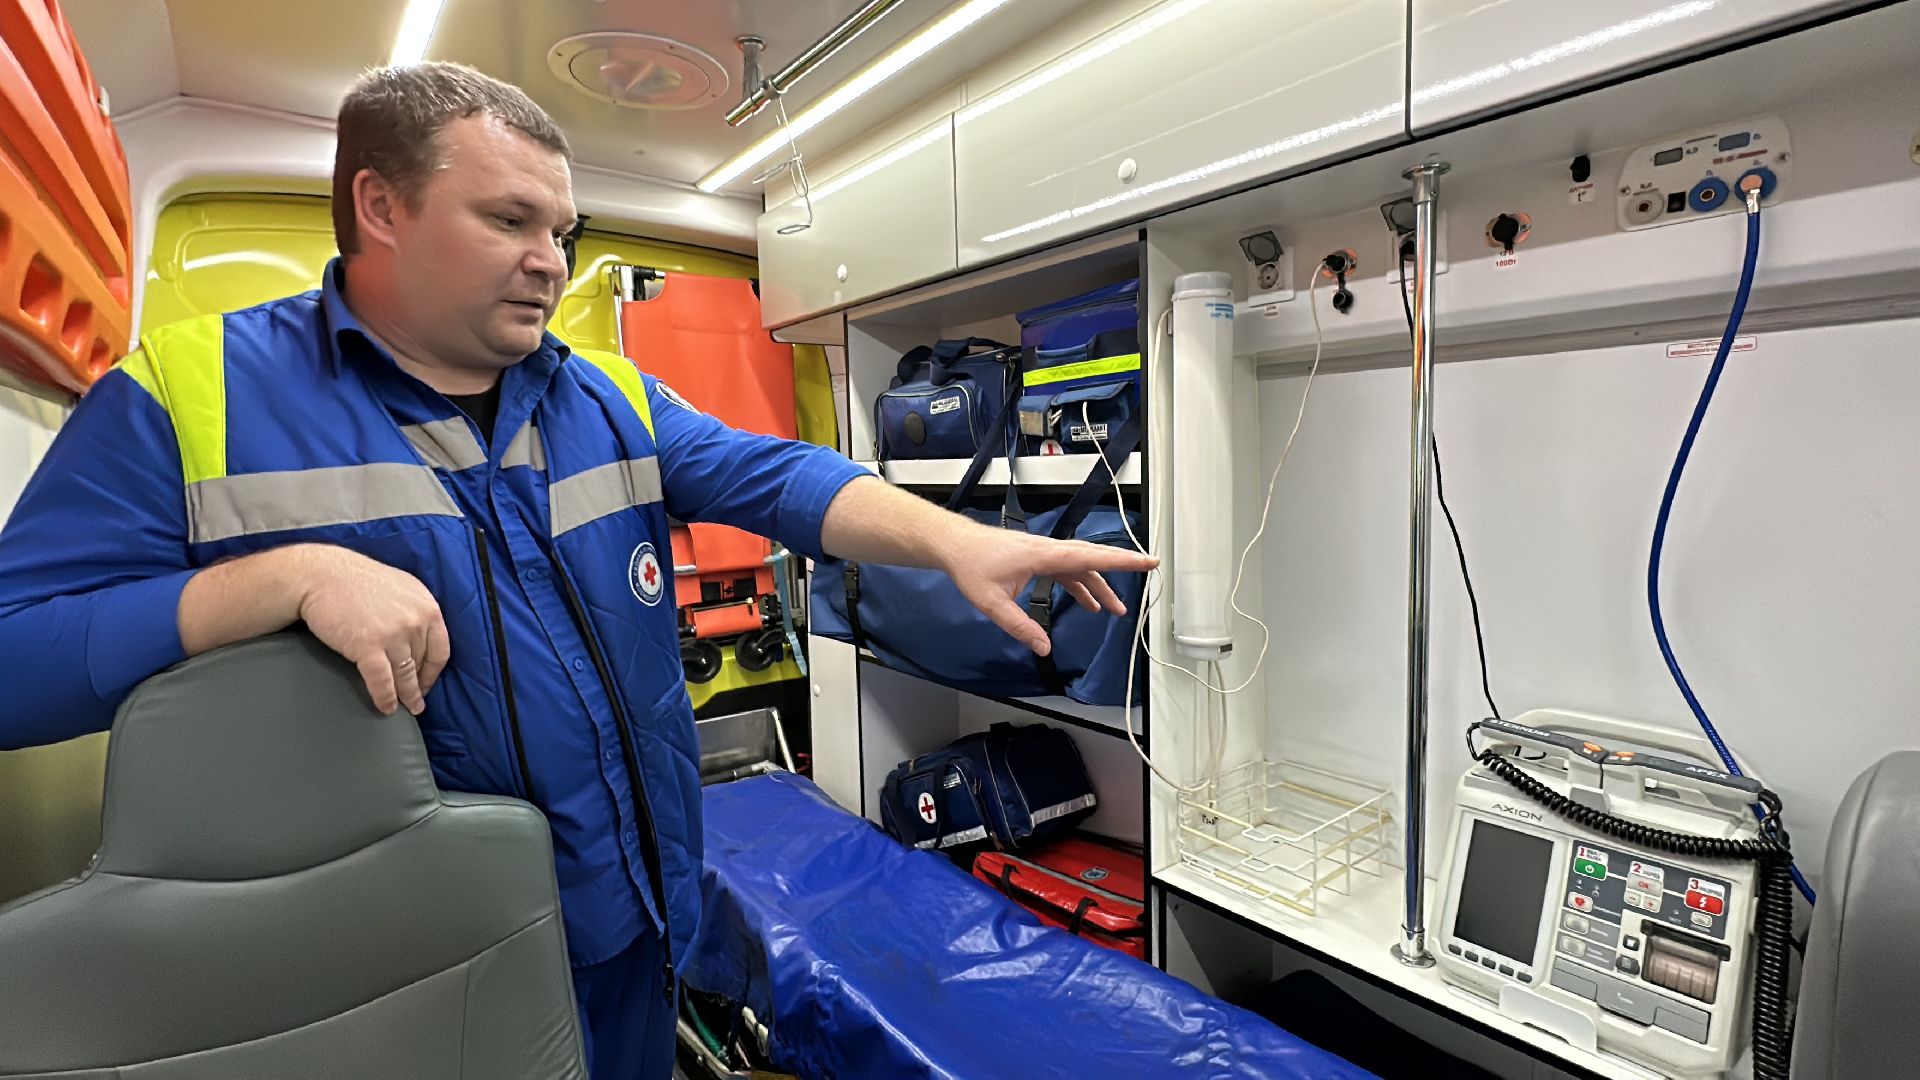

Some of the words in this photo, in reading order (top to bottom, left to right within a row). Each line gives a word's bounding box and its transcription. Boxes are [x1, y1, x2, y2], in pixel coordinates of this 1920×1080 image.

[1685, 766, 1729, 779] APEX
[1491, 803, 1543, 821] AXION
[1578, 847, 1586, 857] 1
[1632, 862, 1642, 874] 2
[1689, 878, 1699, 890] 3
